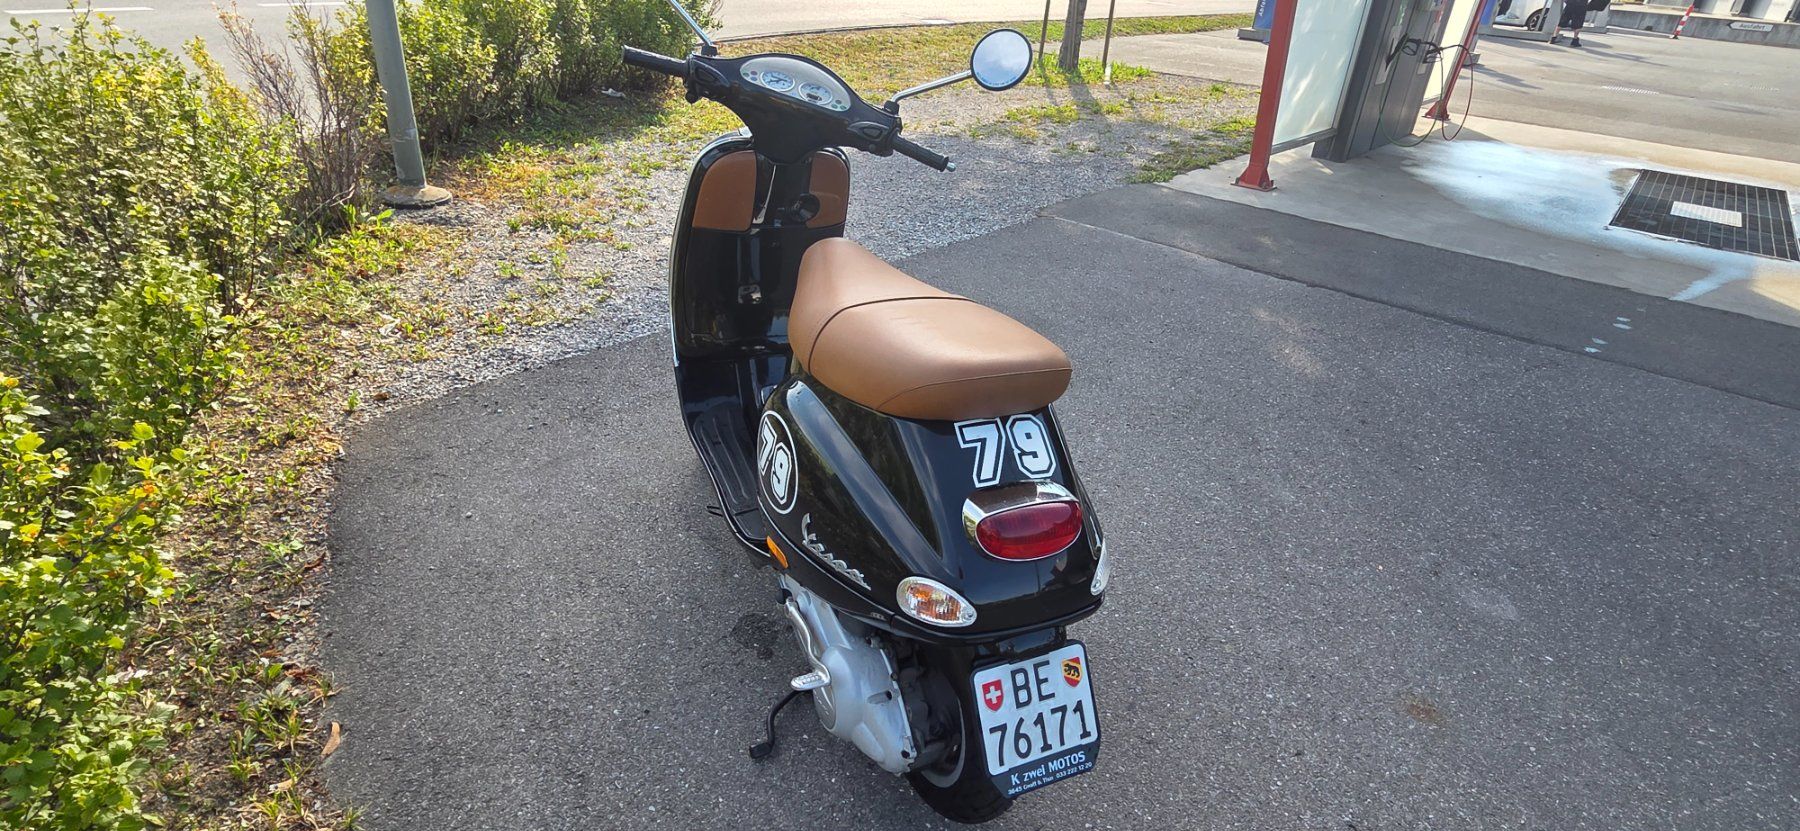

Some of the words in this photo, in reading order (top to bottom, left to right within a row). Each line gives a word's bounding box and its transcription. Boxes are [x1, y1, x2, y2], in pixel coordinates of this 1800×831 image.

[759, 416, 792, 505] 79
[954, 413, 1057, 488] 79
[802, 512, 872, 591] Vespa
[1010, 659, 1056, 709] BE
[988, 699, 1092, 767] 76171
[1011, 773, 1020, 786] K
[1048, 751, 1086, 773] MOTOS
[1056, 770, 1067, 779] 033
[1085, 761, 1093, 769] 20
